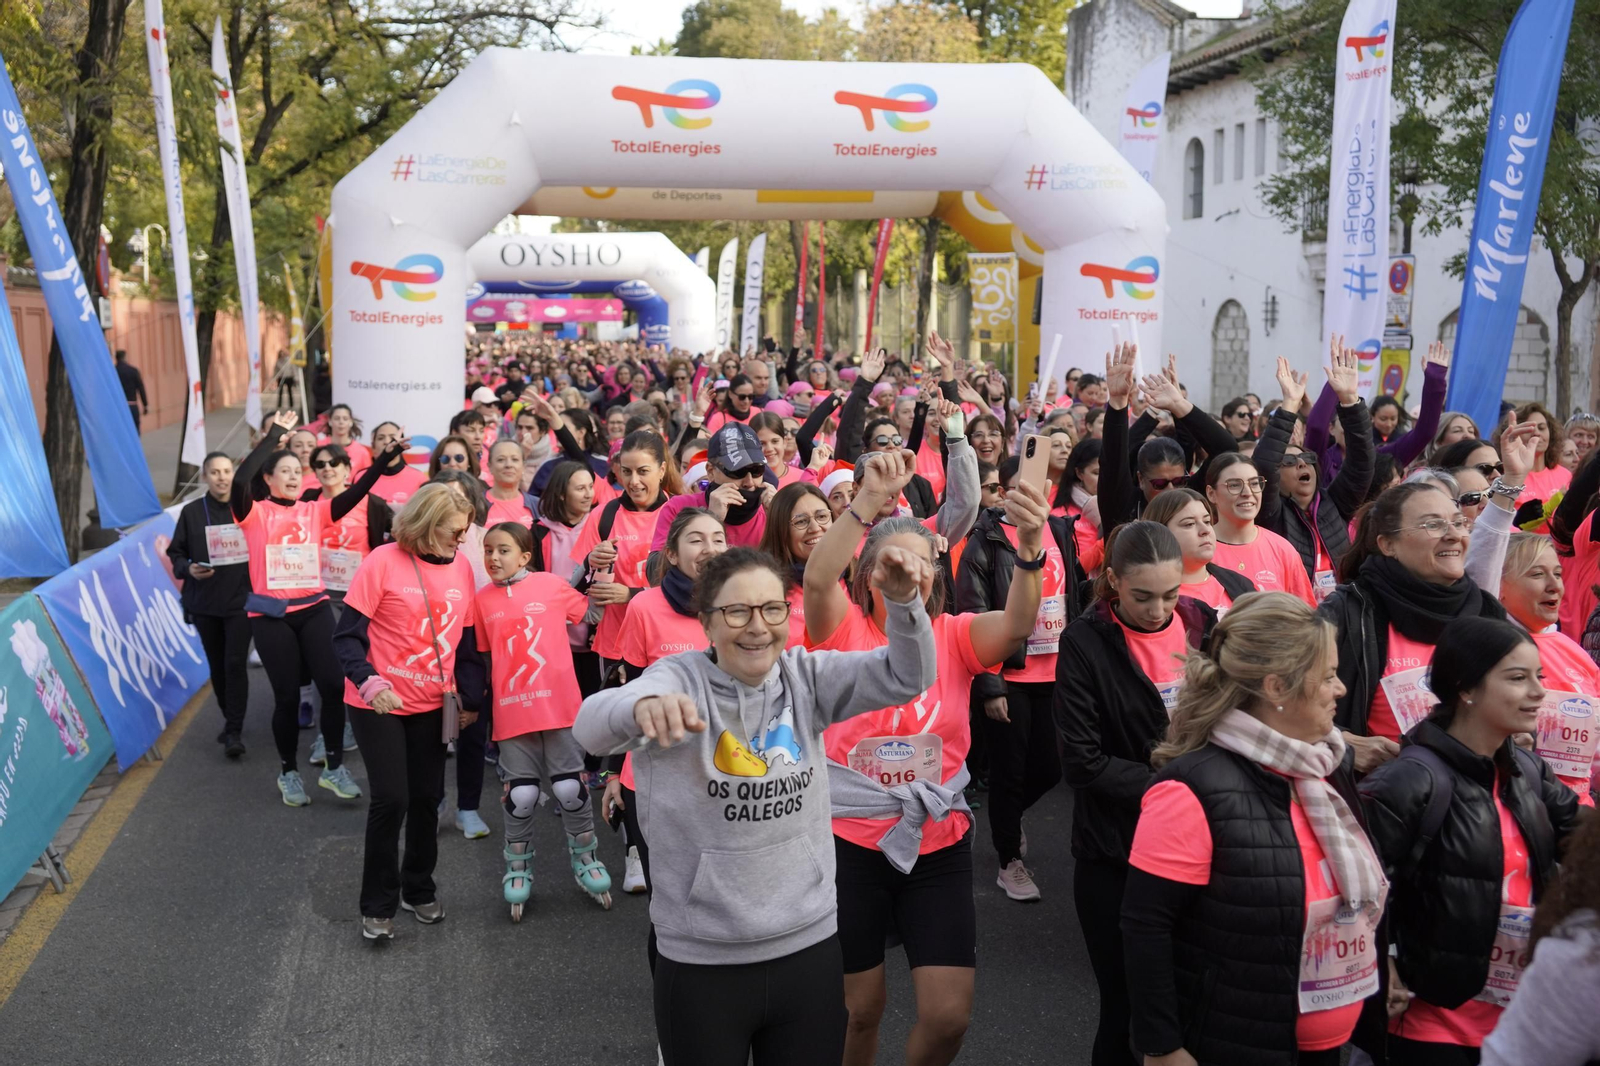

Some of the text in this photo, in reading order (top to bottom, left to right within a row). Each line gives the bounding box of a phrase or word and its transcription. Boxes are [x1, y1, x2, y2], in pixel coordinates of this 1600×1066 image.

[611, 140, 721, 157] TotalEnergies
[833, 143, 937, 159] TotalEnergies
[652, 189, 722, 201] de Deportes
[1473, 111, 1538, 302] Marlene
[501, 242, 622, 267] OYSHO
[746, 261, 760, 340] YSHO
[348, 310, 443, 327] TotalEnergies
[348, 380, 442, 392] totalenergies.es
[725, 427, 743, 467] SEVILLA
[222, 540, 239, 549] 016
[284, 562, 303, 571] 016
[329, 566, 346, 574] 016
[1045, 619, 1063, 630] 016
[660, 643, 695, 651] OYSHO
[1389, 657, 1421, 667] YSHO
[1562, 727, 1589, 742] 016
[1566, 746, 1581, 754] 2378
[1547, 761, 1563, 769] SHO
[880, 770, 916, 785] 016
[707, 779, 730, 799] OS
[724, 794, 803, 821] GALEGOS
[1336, 934, 1366, 958] 016
[1490, 946, 1527, 968] 016
[1315, 979, 1338, 989] CARRERA
[1311, 991, 1345, 1004] OYSHO
